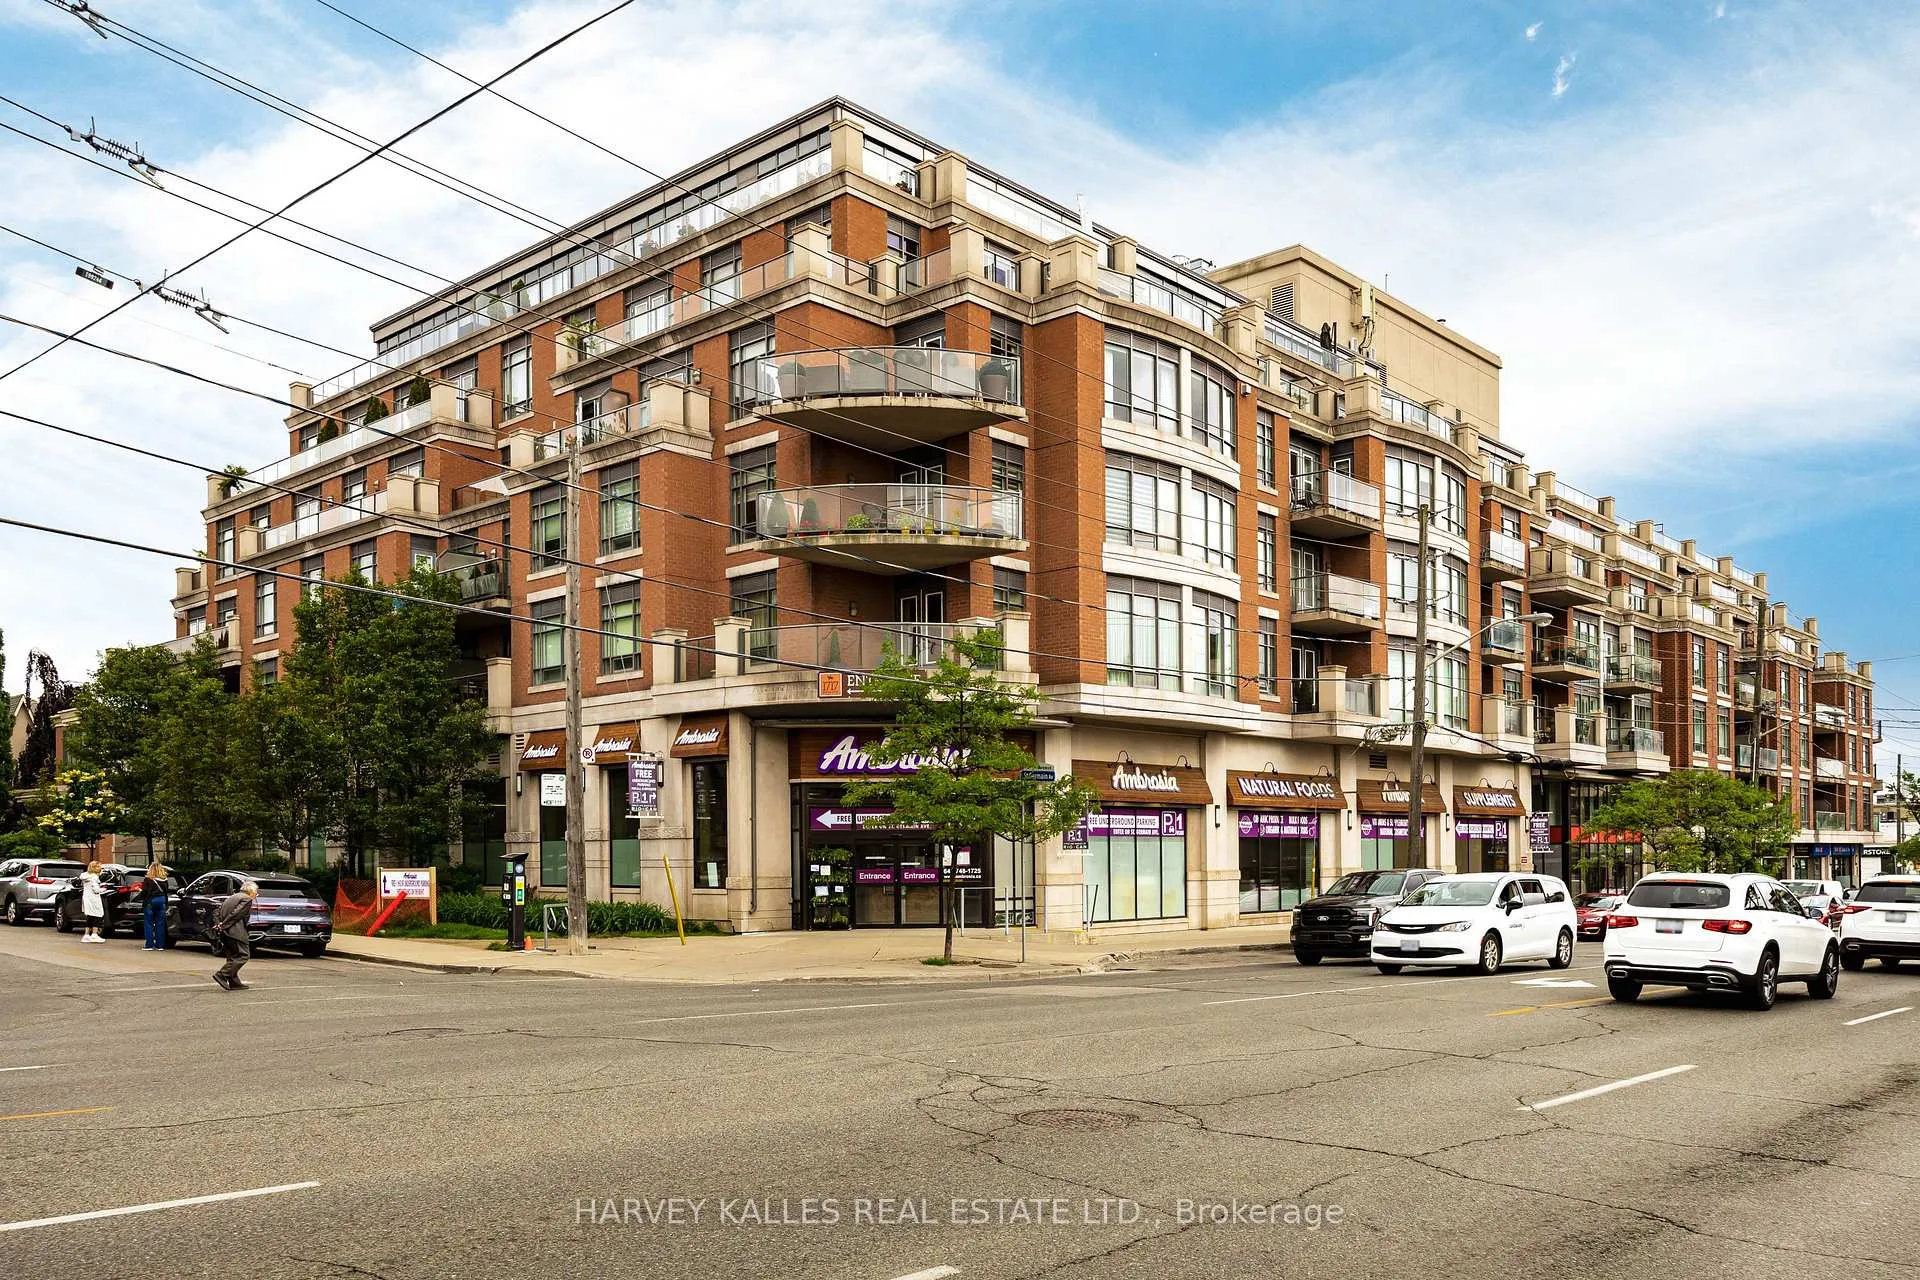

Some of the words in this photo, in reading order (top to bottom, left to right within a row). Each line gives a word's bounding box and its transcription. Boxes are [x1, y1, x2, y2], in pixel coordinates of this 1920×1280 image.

[675, 728, 720, 745] Ambrosia
[523, 744, 559, 759] Ambrosia
[594, 737, 632, 752] Ambrosia
[635, 769, 653, 778] FREE
[1112, 764, 1180, 793] Ambrosia
[1238, 778, 1295, 796] NATURAL
[1294, 781, 1335, 798] FOODS
[1463, 791, 1516, 808] SUPPLEMENTS
[837, 815, 851, 823] FREE
[859, 872, 891, 880] Entrance
[903, 872, 936, 880] Entrance
